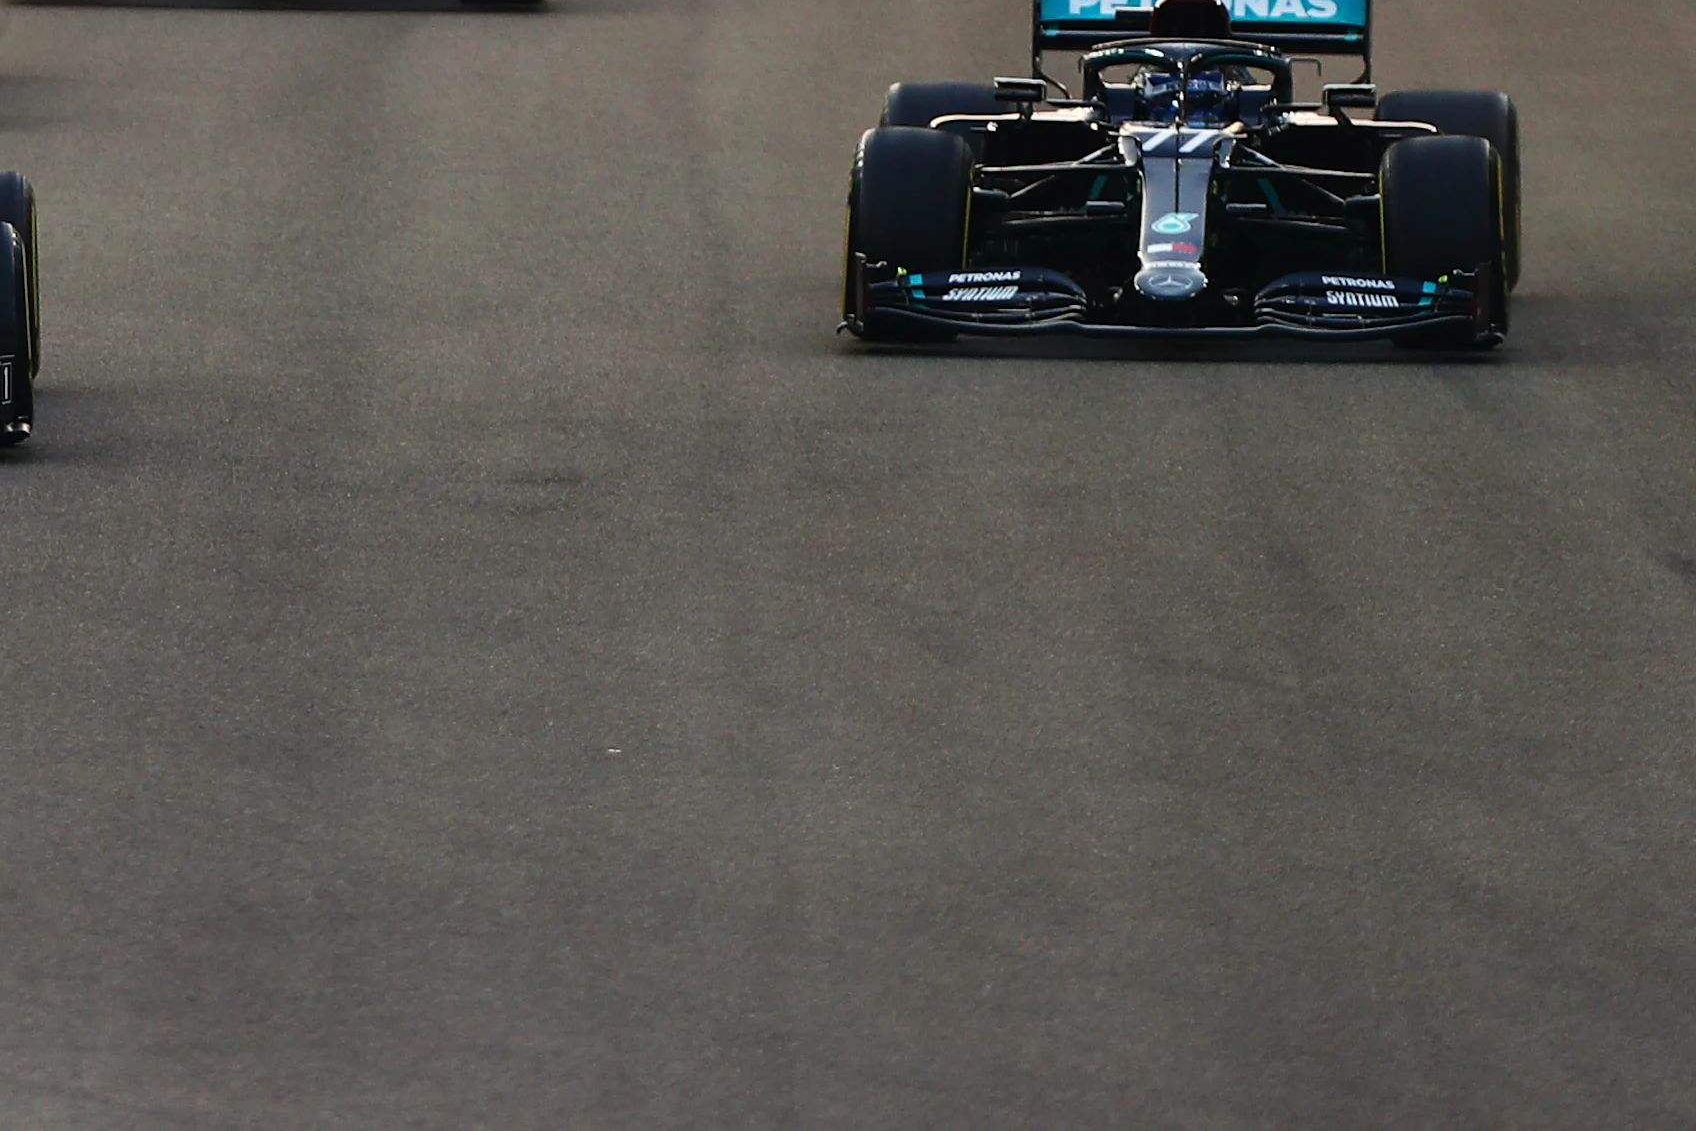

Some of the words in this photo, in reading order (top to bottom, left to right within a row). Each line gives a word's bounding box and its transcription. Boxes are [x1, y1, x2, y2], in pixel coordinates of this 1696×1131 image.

[1142, 128, 1219, 154] 77
[948, 270, 1021, 284] PETRONAS
[1321, 275, 1396, 290] PETRONAS
[1326, 290, 1400, 308] SYNTIUM
